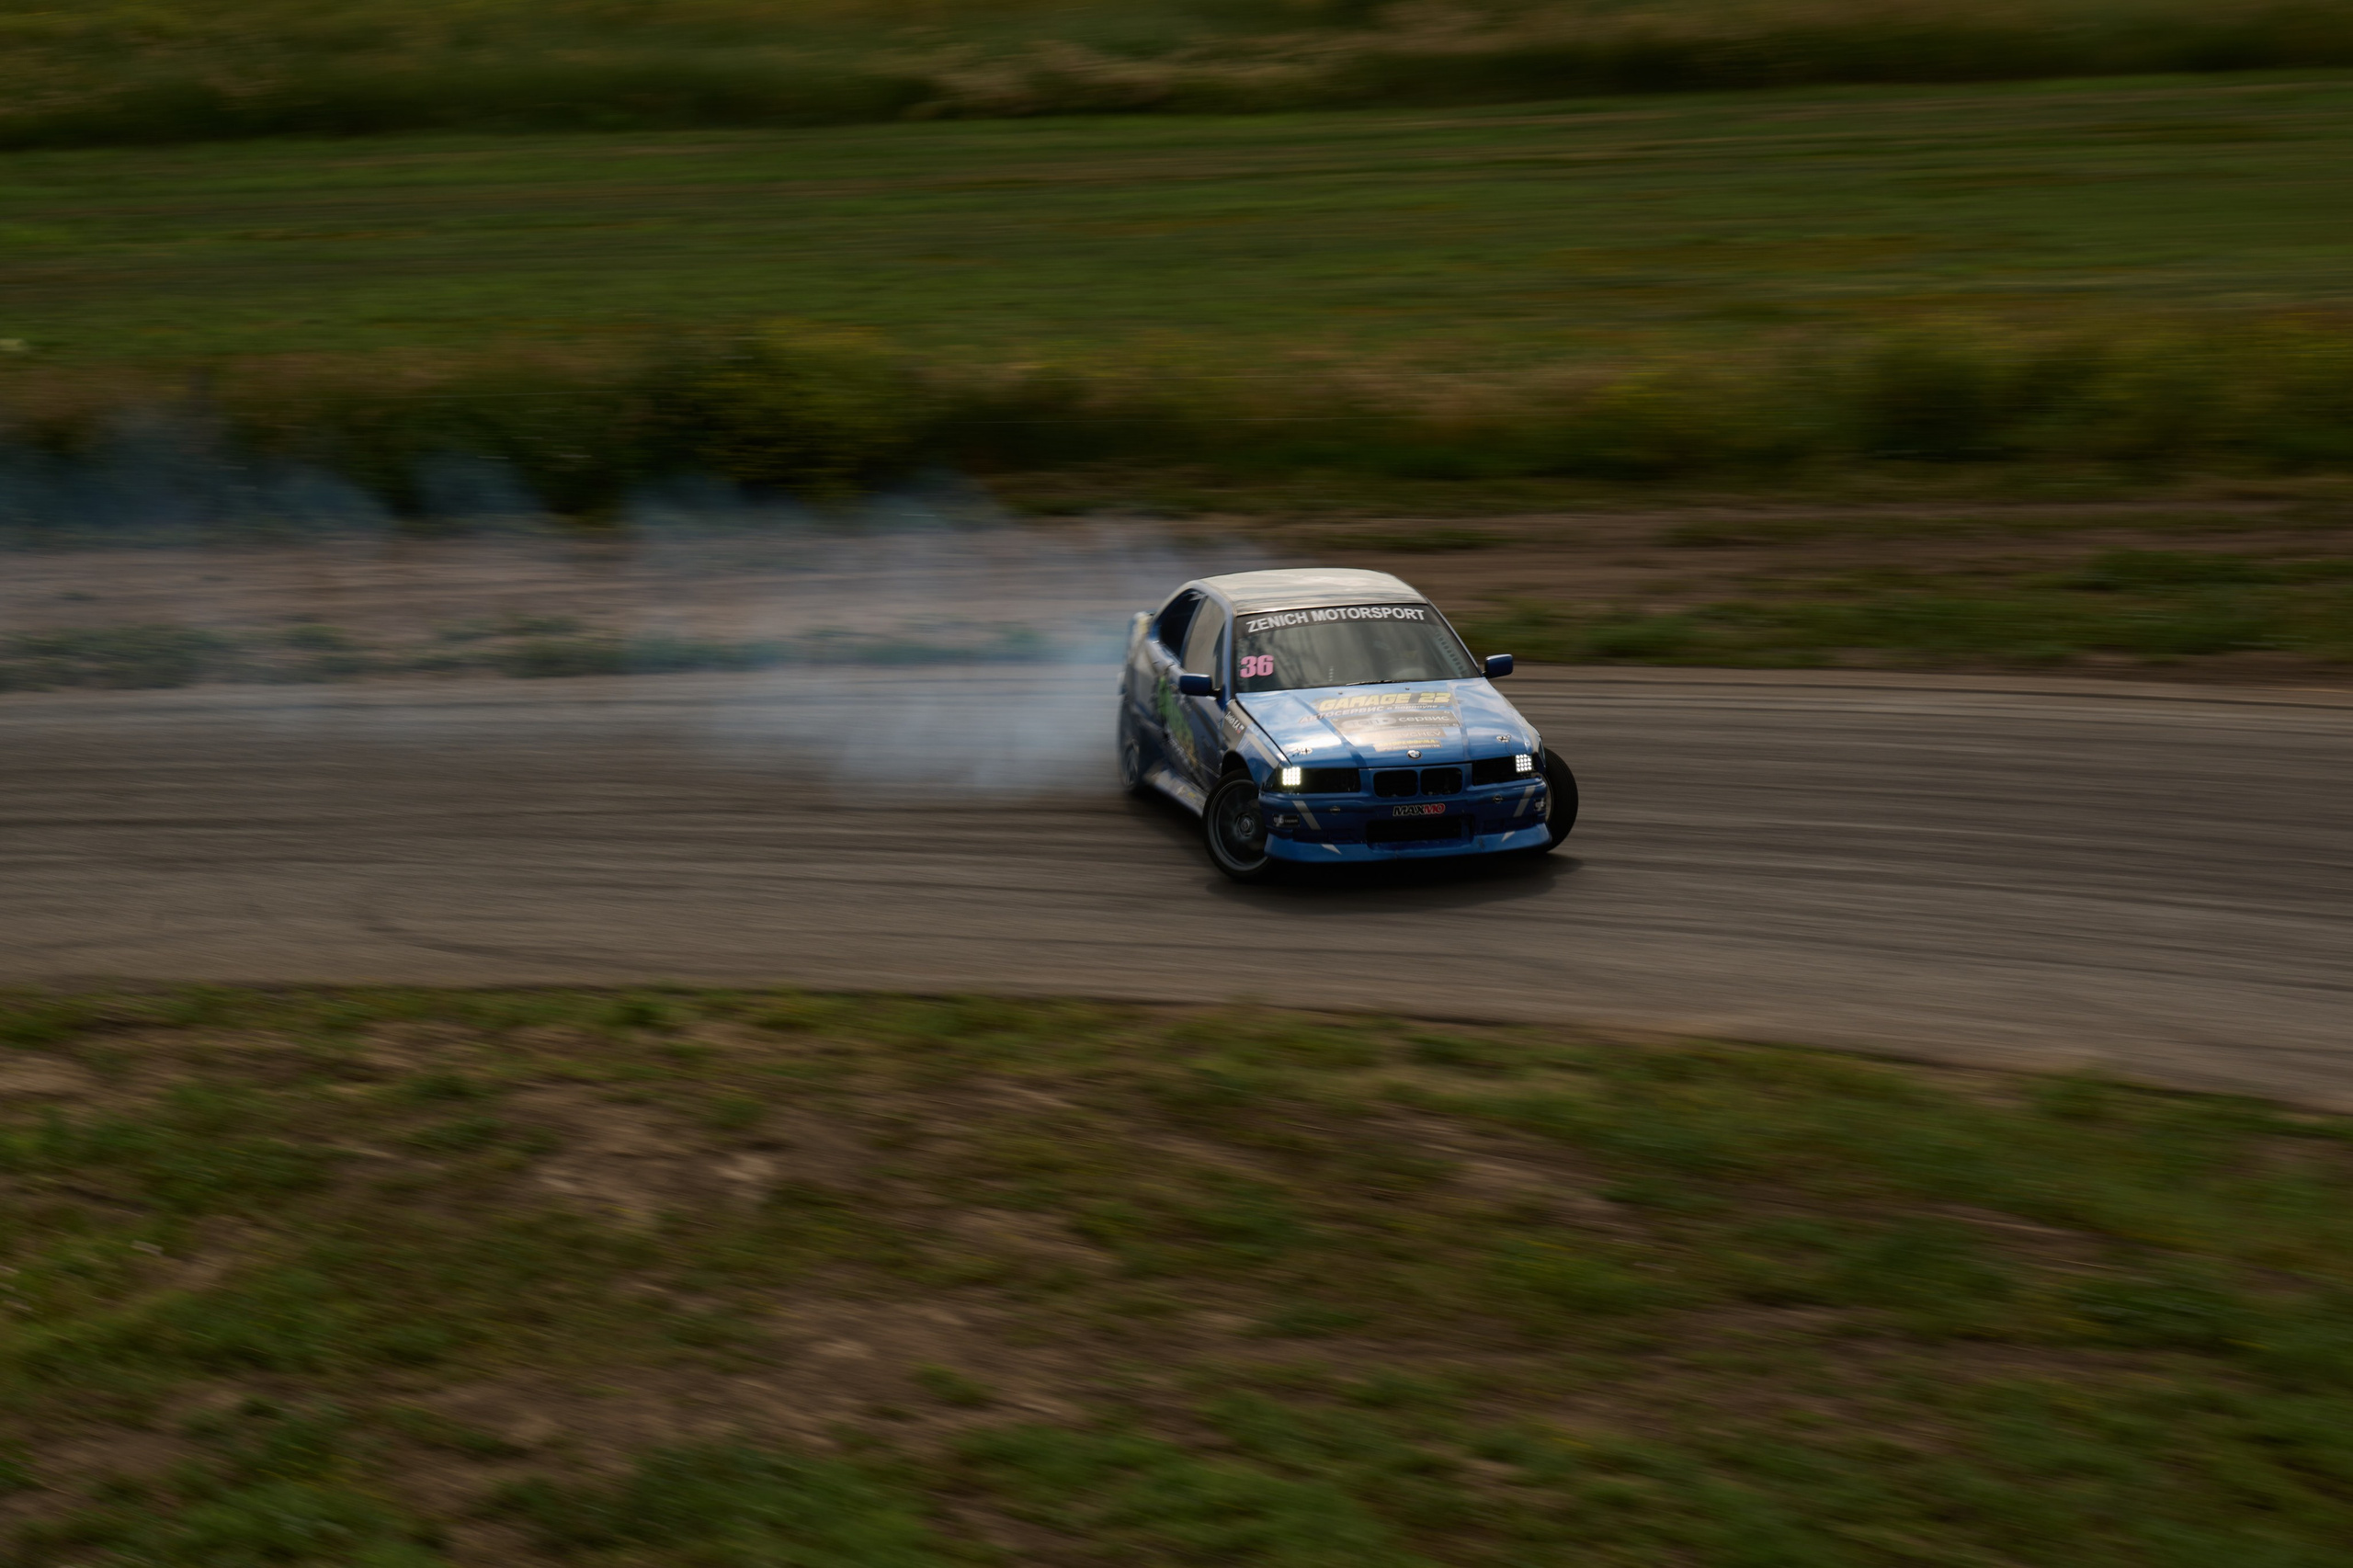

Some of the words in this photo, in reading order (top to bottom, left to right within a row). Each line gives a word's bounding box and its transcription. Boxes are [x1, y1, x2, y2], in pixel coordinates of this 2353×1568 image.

[1246, 613, 1308, 633] ZENICH
[1312, 608, 1425, 622] MOTORSPORT
[1240, 654, 1274, 678] 36
[1319, 694, 1411, 711] GARAGE
[1418, 692, 1451, 703] 22
[1300, 706, 1384, 723] АВТОСЕРВИС
[1392, 803, 1446, 816] MAXMO
